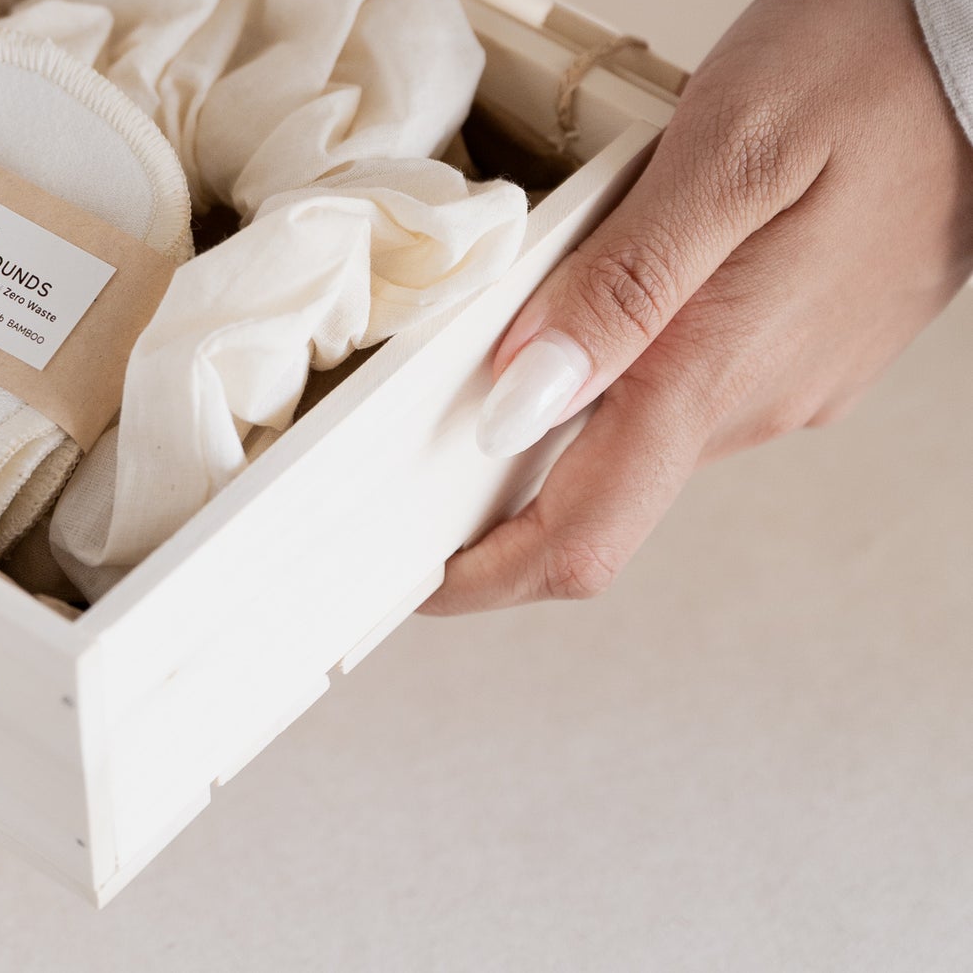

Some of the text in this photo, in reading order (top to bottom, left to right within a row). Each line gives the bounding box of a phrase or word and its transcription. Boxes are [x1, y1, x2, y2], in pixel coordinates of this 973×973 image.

[3, 287, 26, 305] Zero
[27, 300, 57, 323] Waste
[6, 319, 45, 345] BAMBOO
